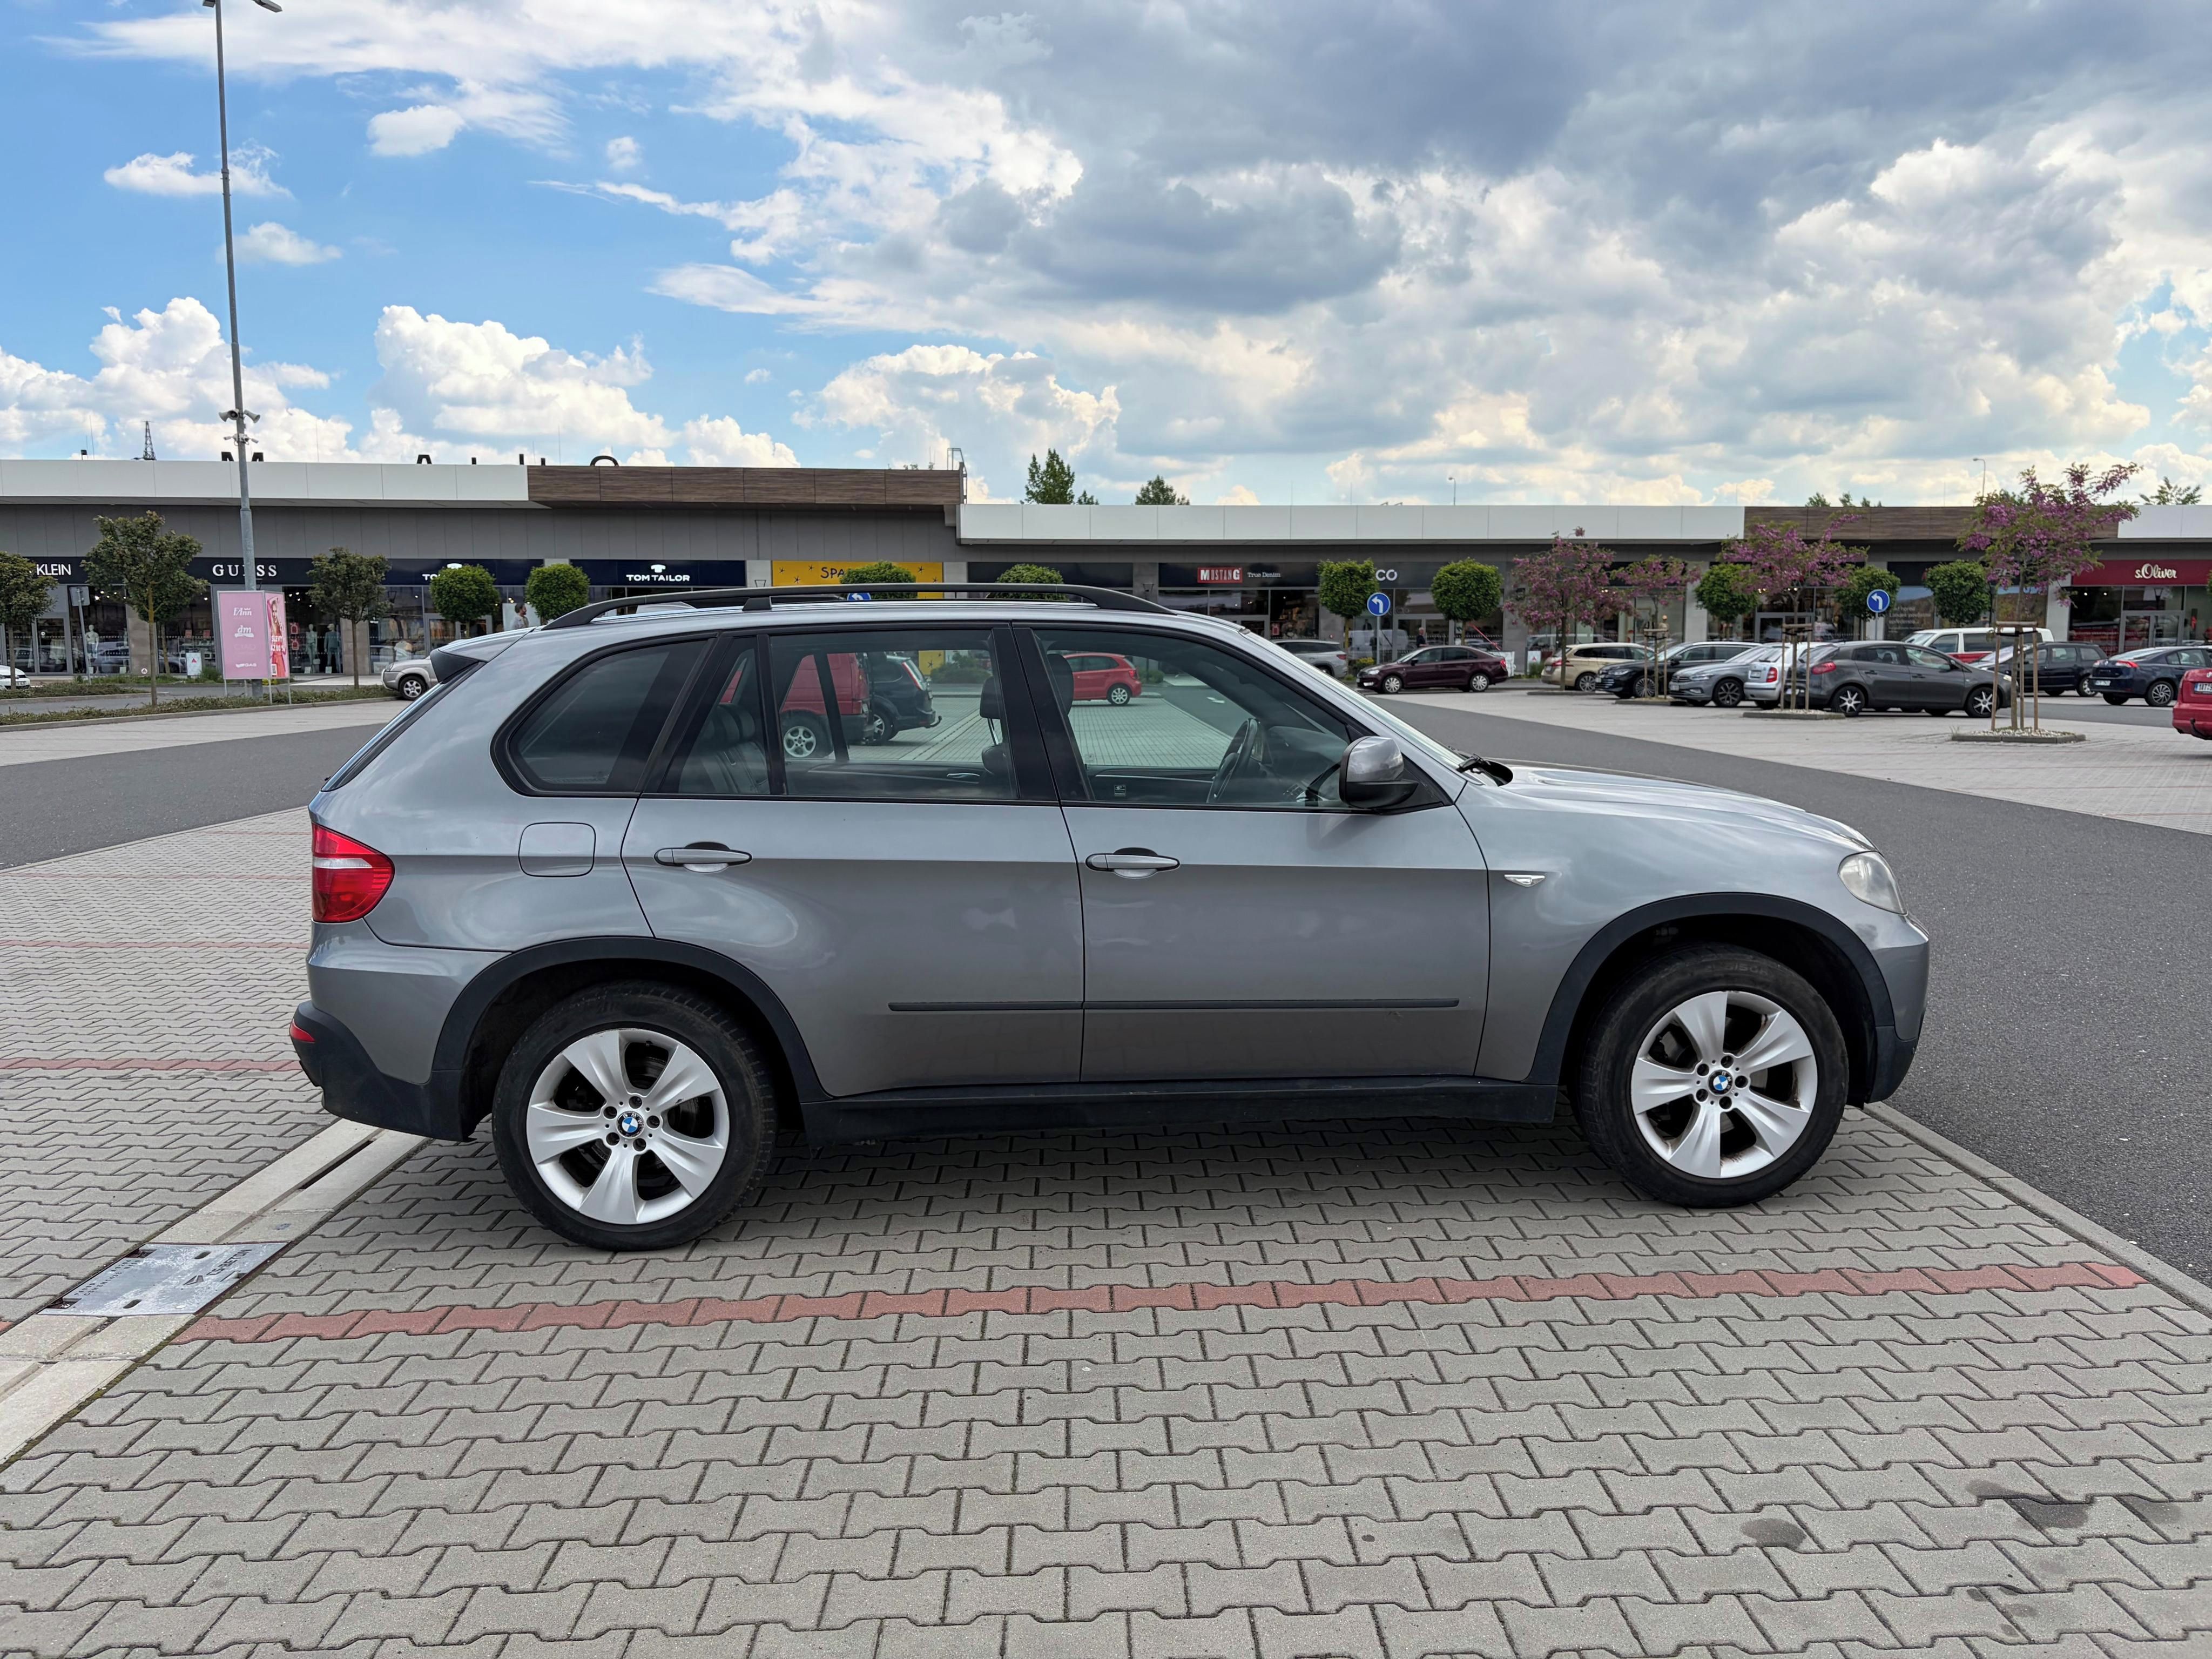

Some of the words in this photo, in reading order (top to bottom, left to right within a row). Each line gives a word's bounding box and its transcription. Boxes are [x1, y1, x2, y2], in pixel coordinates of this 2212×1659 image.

[36, 564, 71, 576] KLEIN
[212, 564, 277, 577] GUSS
[1200, 569, 1240, 581] MUSTANG
[237, 625, 251, 633] dm
